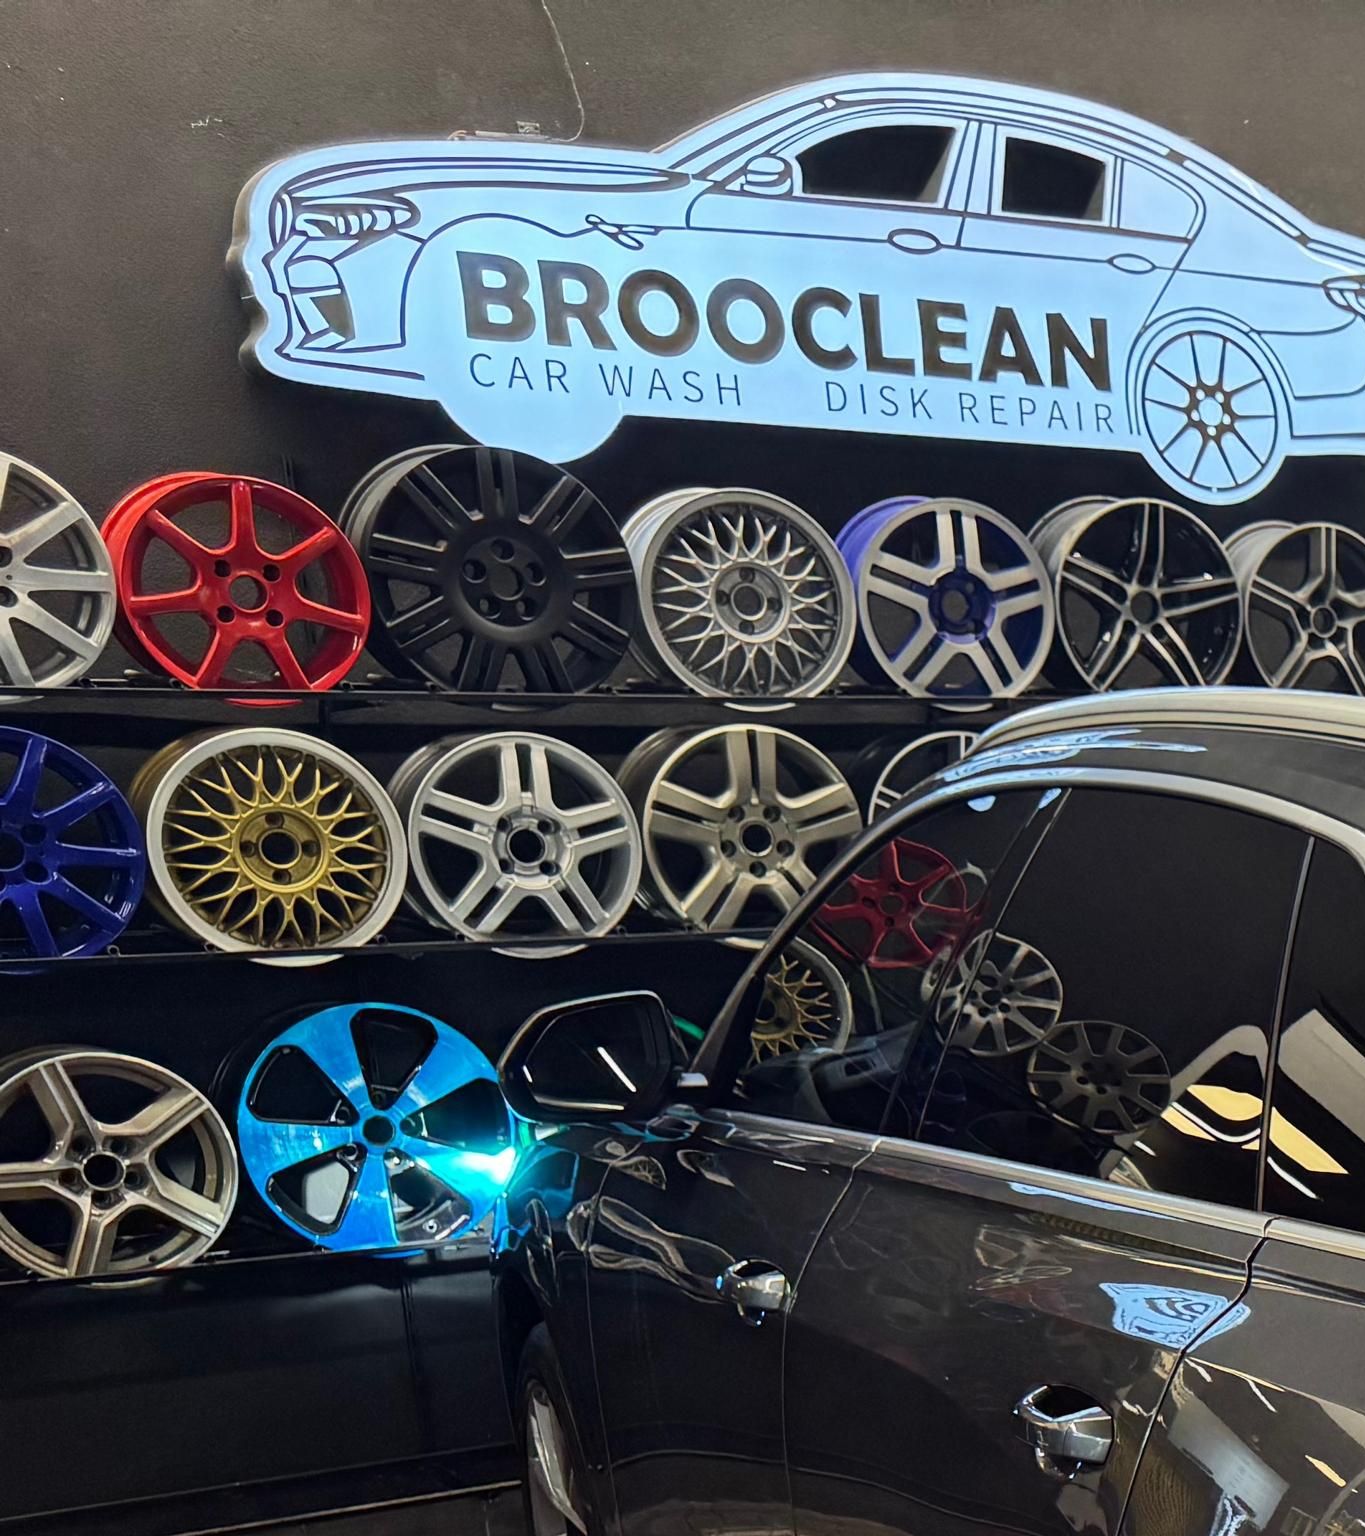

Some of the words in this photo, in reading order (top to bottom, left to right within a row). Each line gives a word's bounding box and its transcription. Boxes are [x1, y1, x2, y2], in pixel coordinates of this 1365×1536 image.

[456, 250, 1113, 393] BROOCLEAN
[469, 352, 571, 394] CAR
[598, 363, 742, 407] WASH
[825, 380, 934, 420] DISK
[959, 391, 1115, 435] REPAIR
